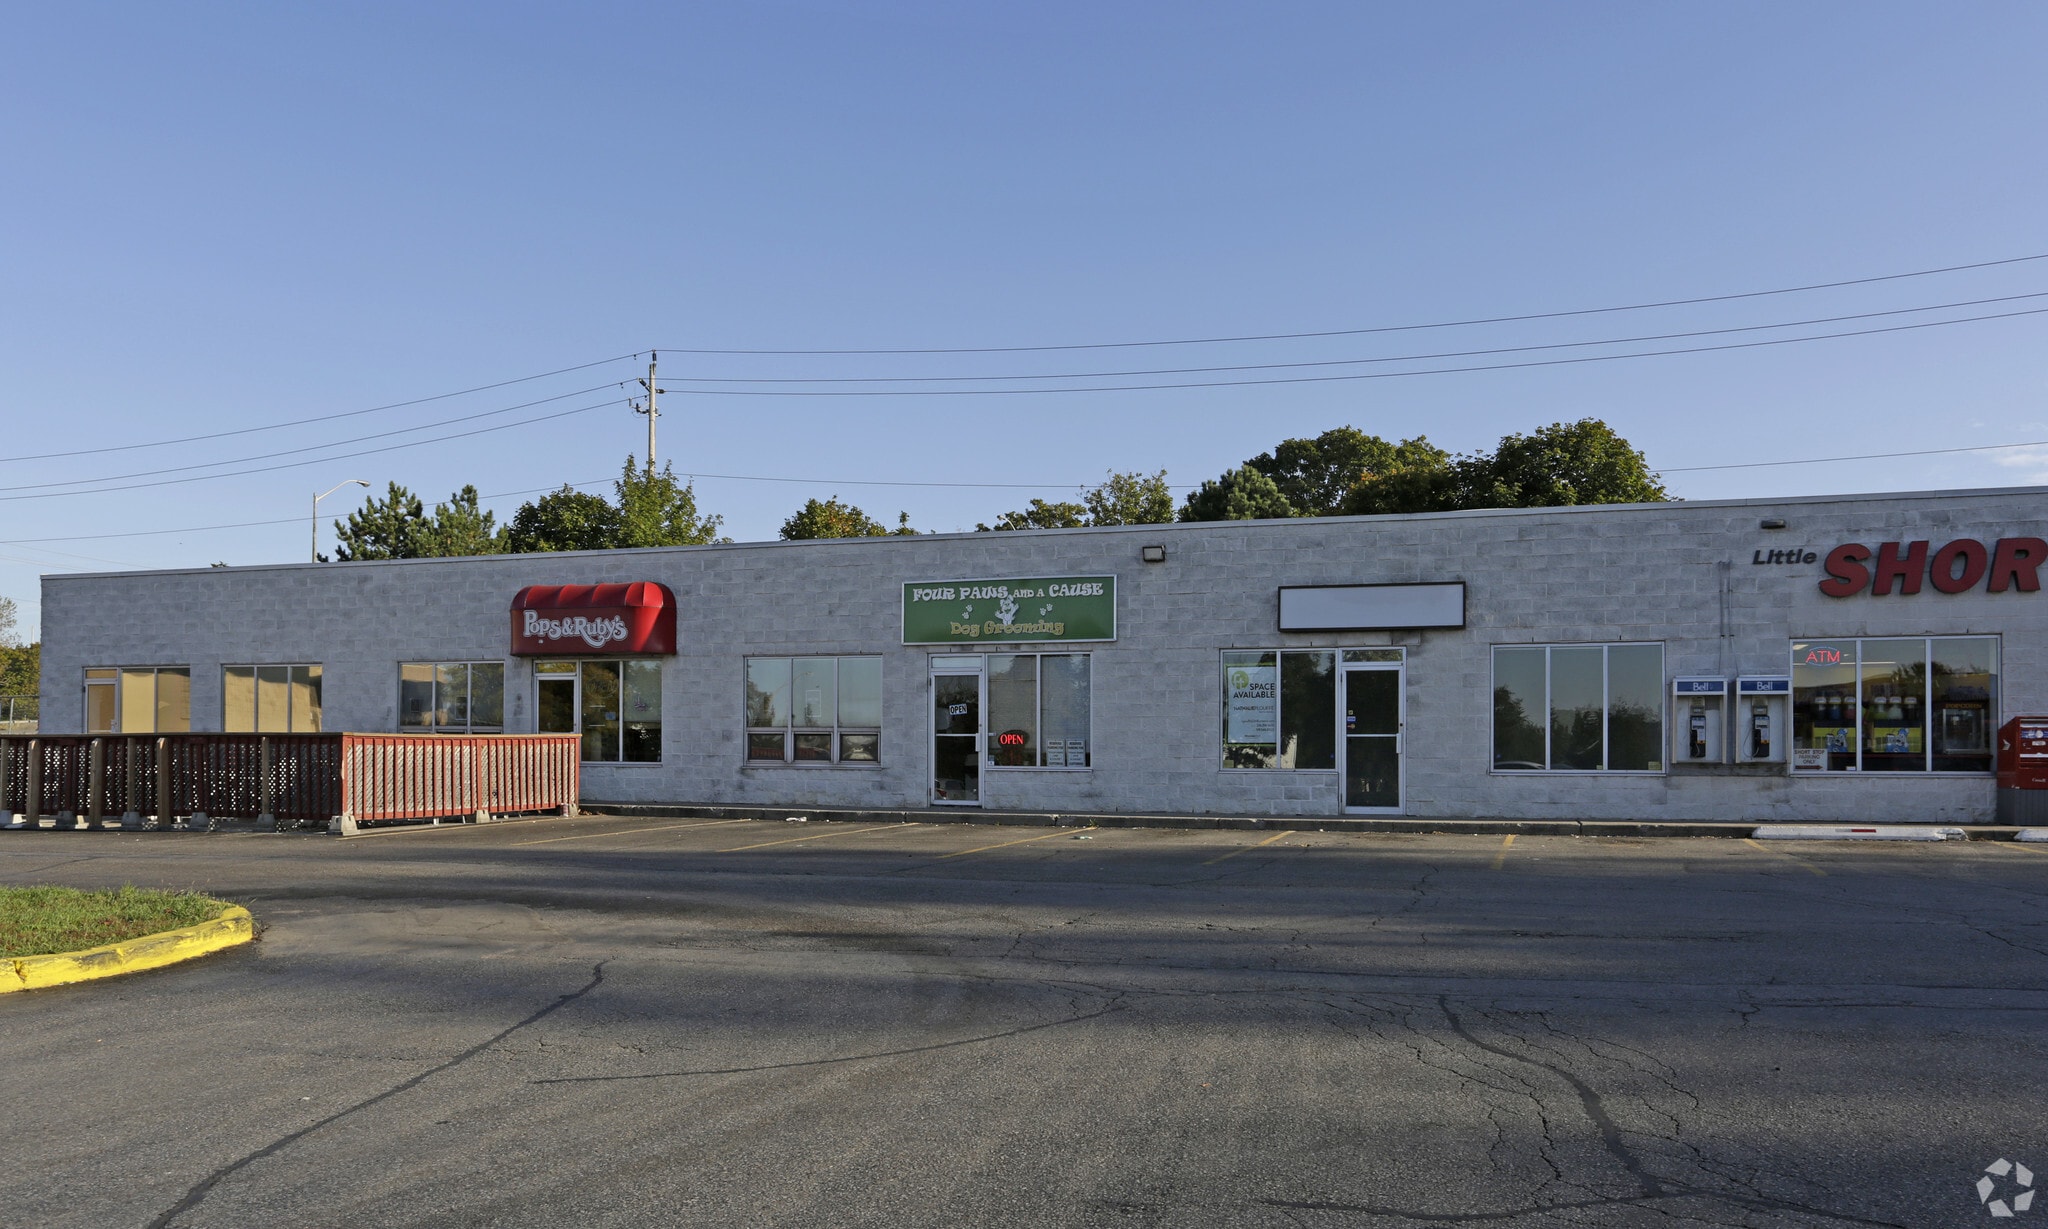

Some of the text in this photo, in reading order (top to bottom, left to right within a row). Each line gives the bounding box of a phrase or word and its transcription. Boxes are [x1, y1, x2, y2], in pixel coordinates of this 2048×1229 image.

[912, 582, 1104, 602] FOUR PAWS AND A CAUSE
[950, 619, 1065, 638] Dog Grooming
[1805, 650, 1841, 663] ATM
[1249, 682, 1275, 691] SPACE
[1693, 682, 1709, 691] Bell
[1757, 681, 1773, 691] Bell
[1233, 690, 1275, 699] AVAILABLE
[950, 705, 967, 714] OPEN
[1000, 734, 1024, 745] OPEN
